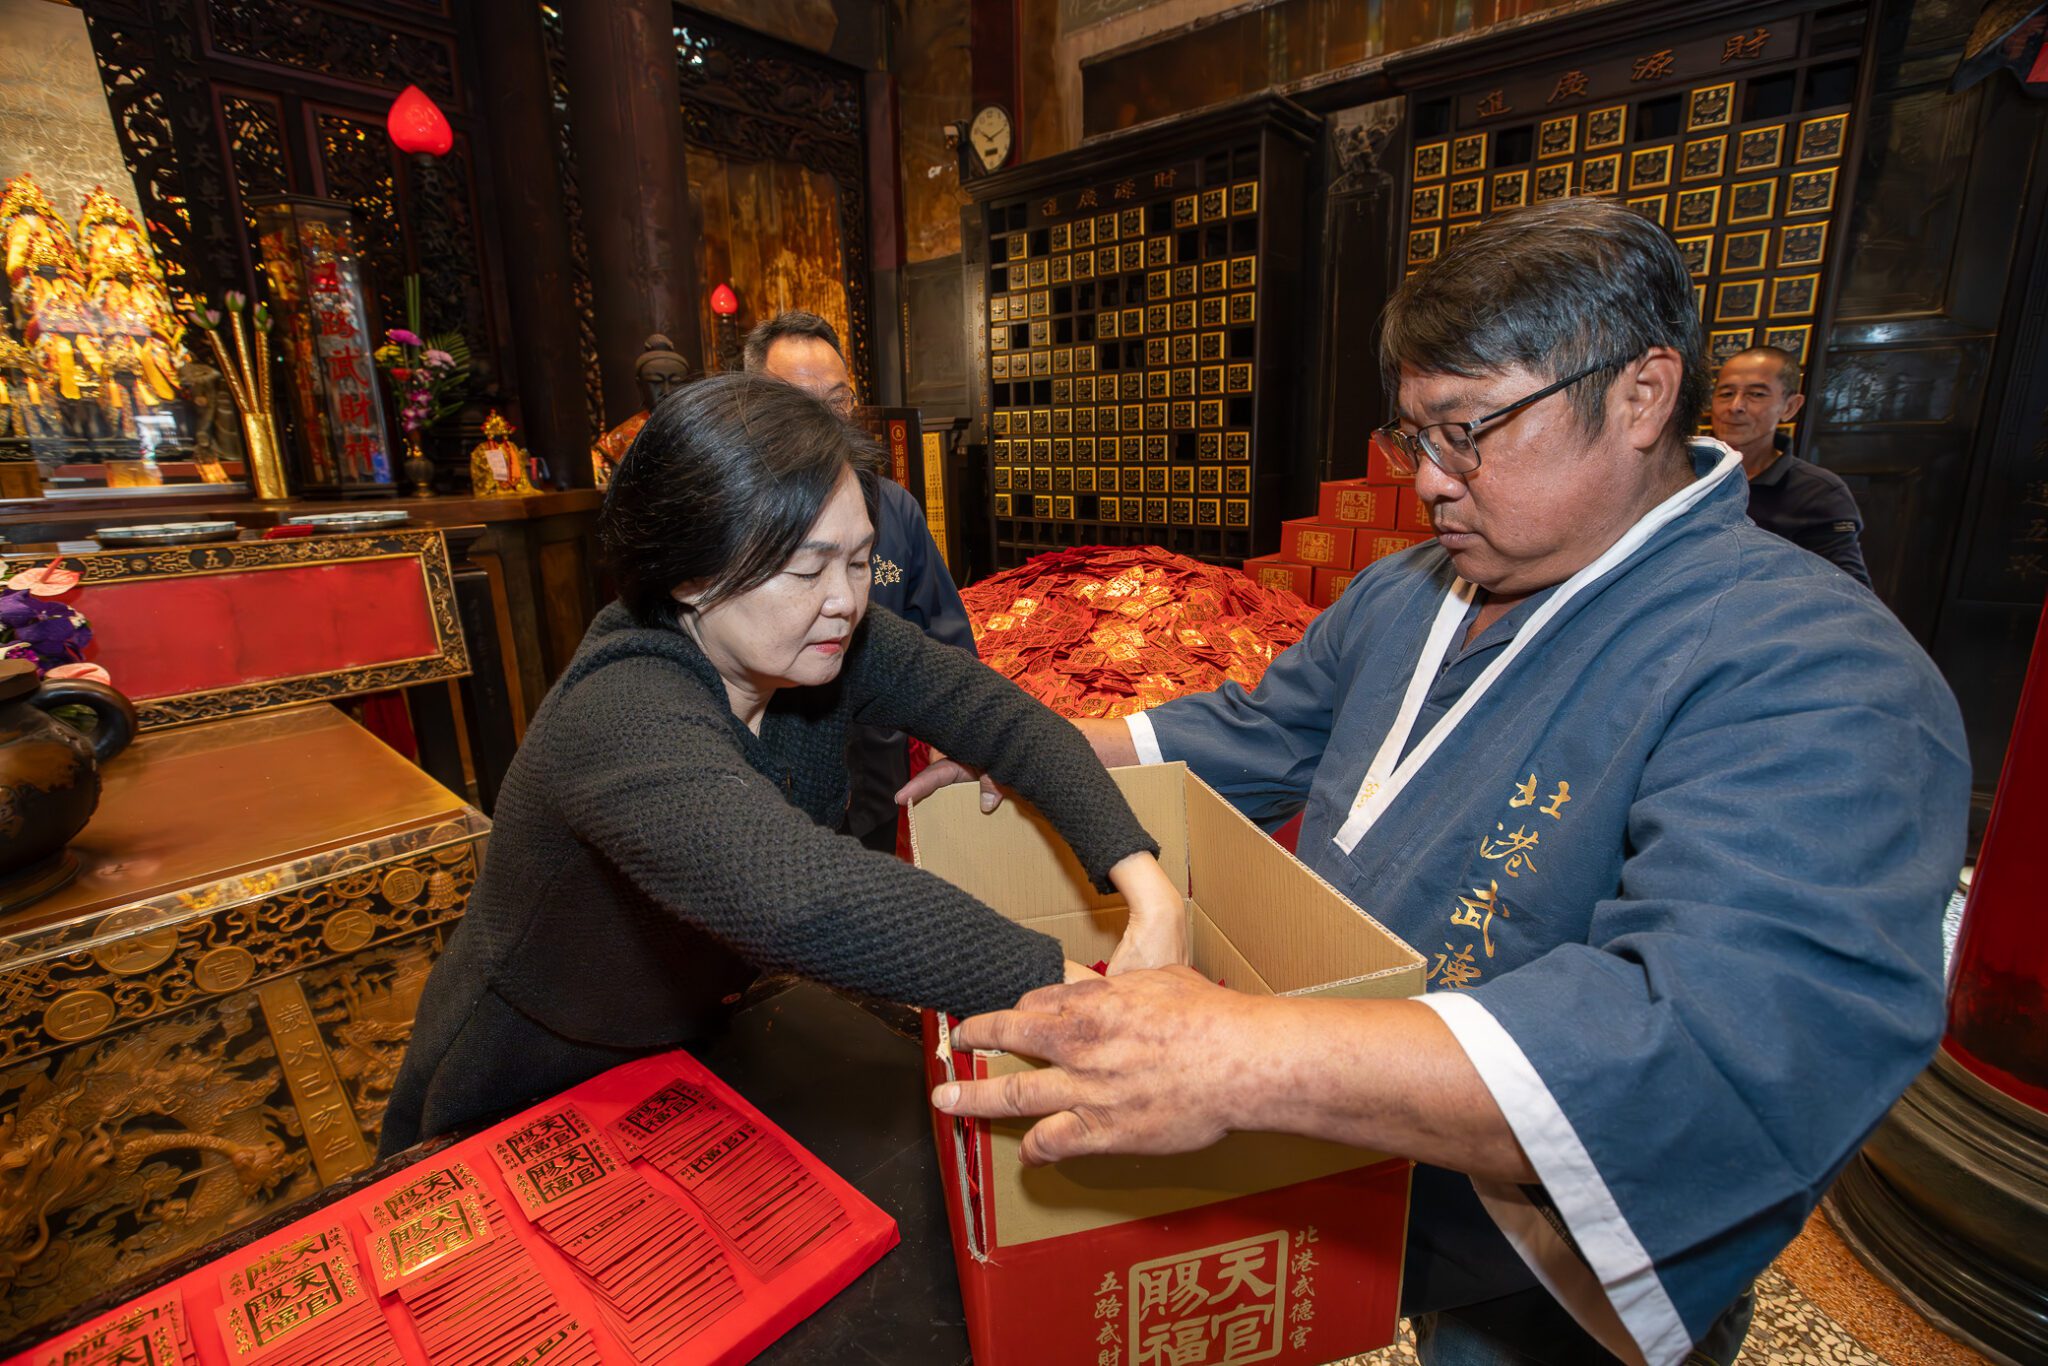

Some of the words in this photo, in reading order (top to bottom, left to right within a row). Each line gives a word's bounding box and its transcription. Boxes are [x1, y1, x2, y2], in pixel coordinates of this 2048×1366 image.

[316, 262, 378, 472] 五路武財神
[204, 549, 224, 569] 五
[331, 915, 371, 945] 天
[204, 956, 244, 984] 官
[58, 998, 108, 1031] 五
[1139, 1258, 1210, 1366] 賜福
[1207, 1246, 1277, 1362] 天官
[1289, 1225, 1321, 1350] 北港武德宮
